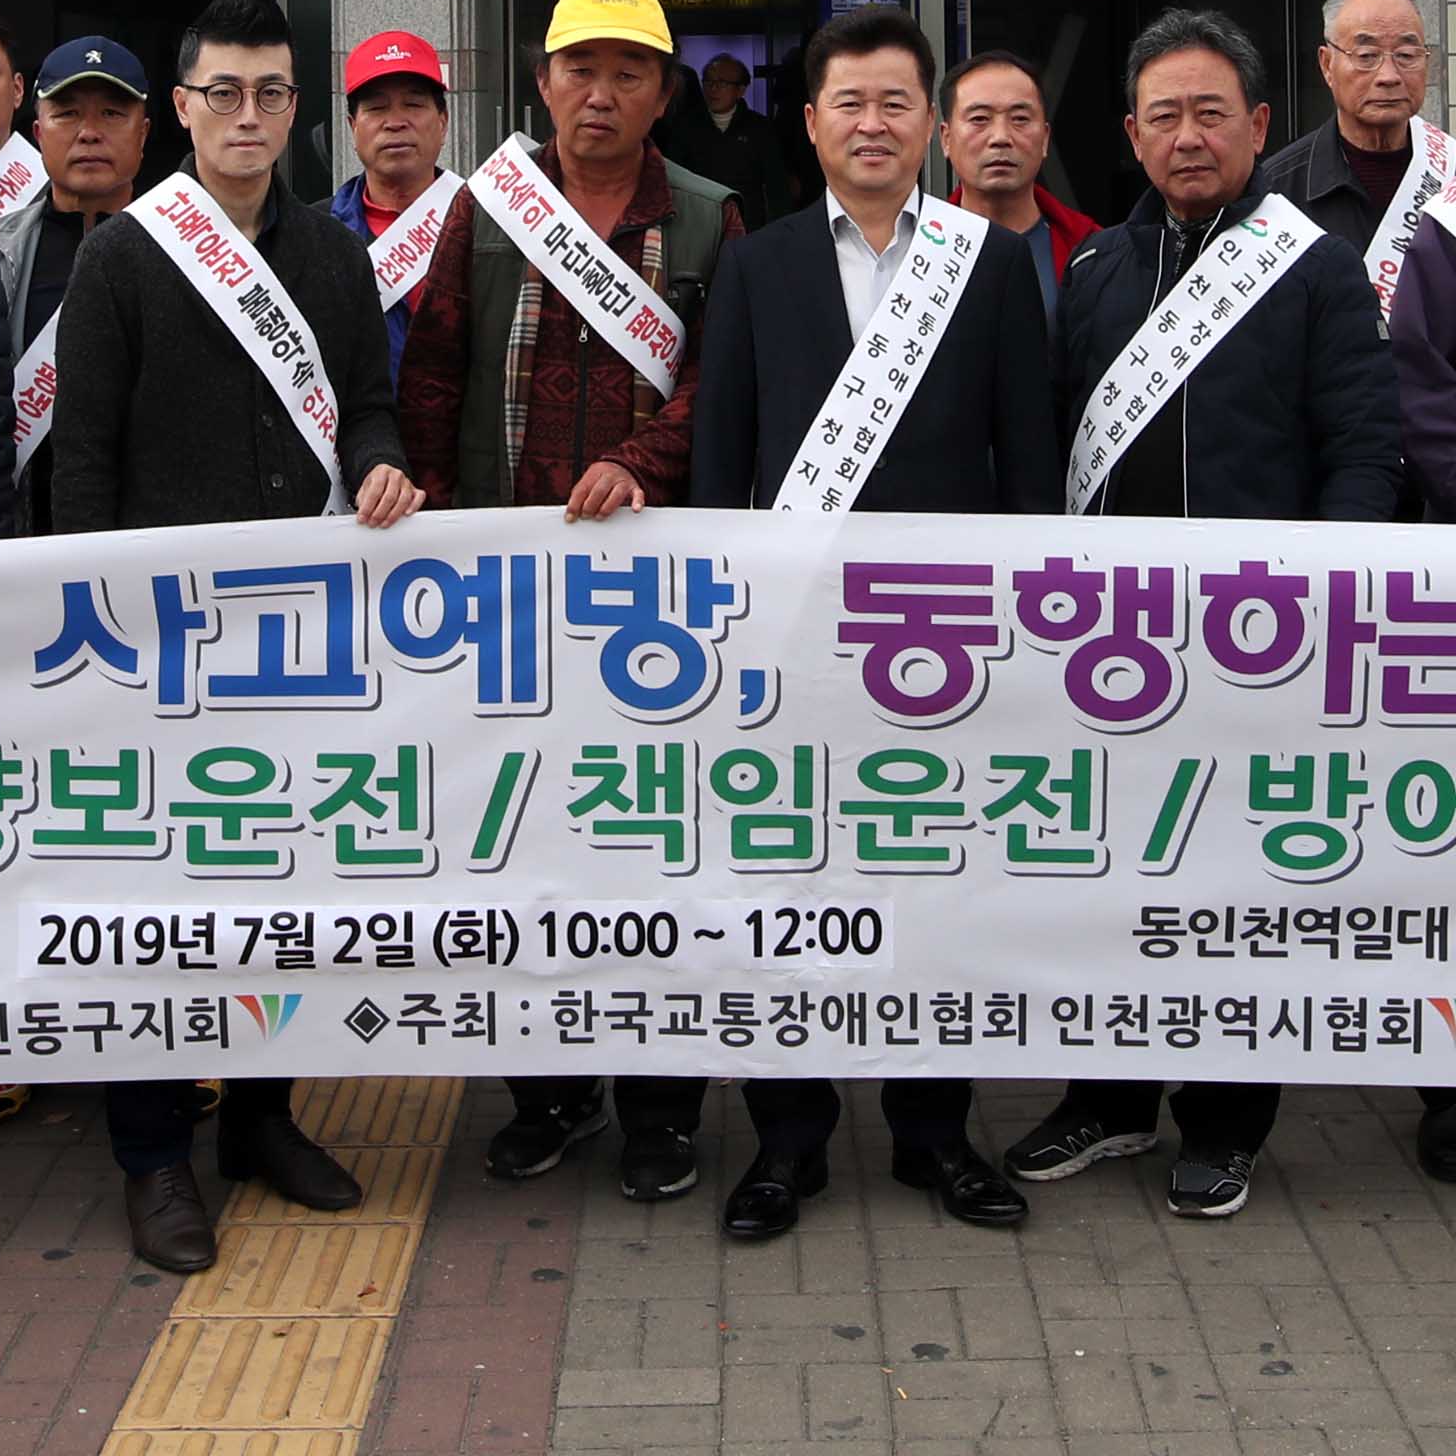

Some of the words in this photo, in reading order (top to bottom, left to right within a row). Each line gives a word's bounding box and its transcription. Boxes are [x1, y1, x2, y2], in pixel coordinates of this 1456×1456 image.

[32, 551, 776, 718] 사고예방,
[566, 741, 1100, 869] 책임운전
[36, 910, 217, 968] 2019년
[234, 910, 316, 969] 7월
[331, 910, 415, 967] 2일
[432, 905, 518, 968] (화)
[537, 909, 679, 961] 10:00
[744, 905, 884, 960] 12:00
[1132, 904, 1450, 963] 동인천역일대
[396, 990, 499, 1047] 주최
[551, 988, 1029, 1048] 한국교통장애인협회
[1051, 993, 1424, 1056] 인천광역시협회
